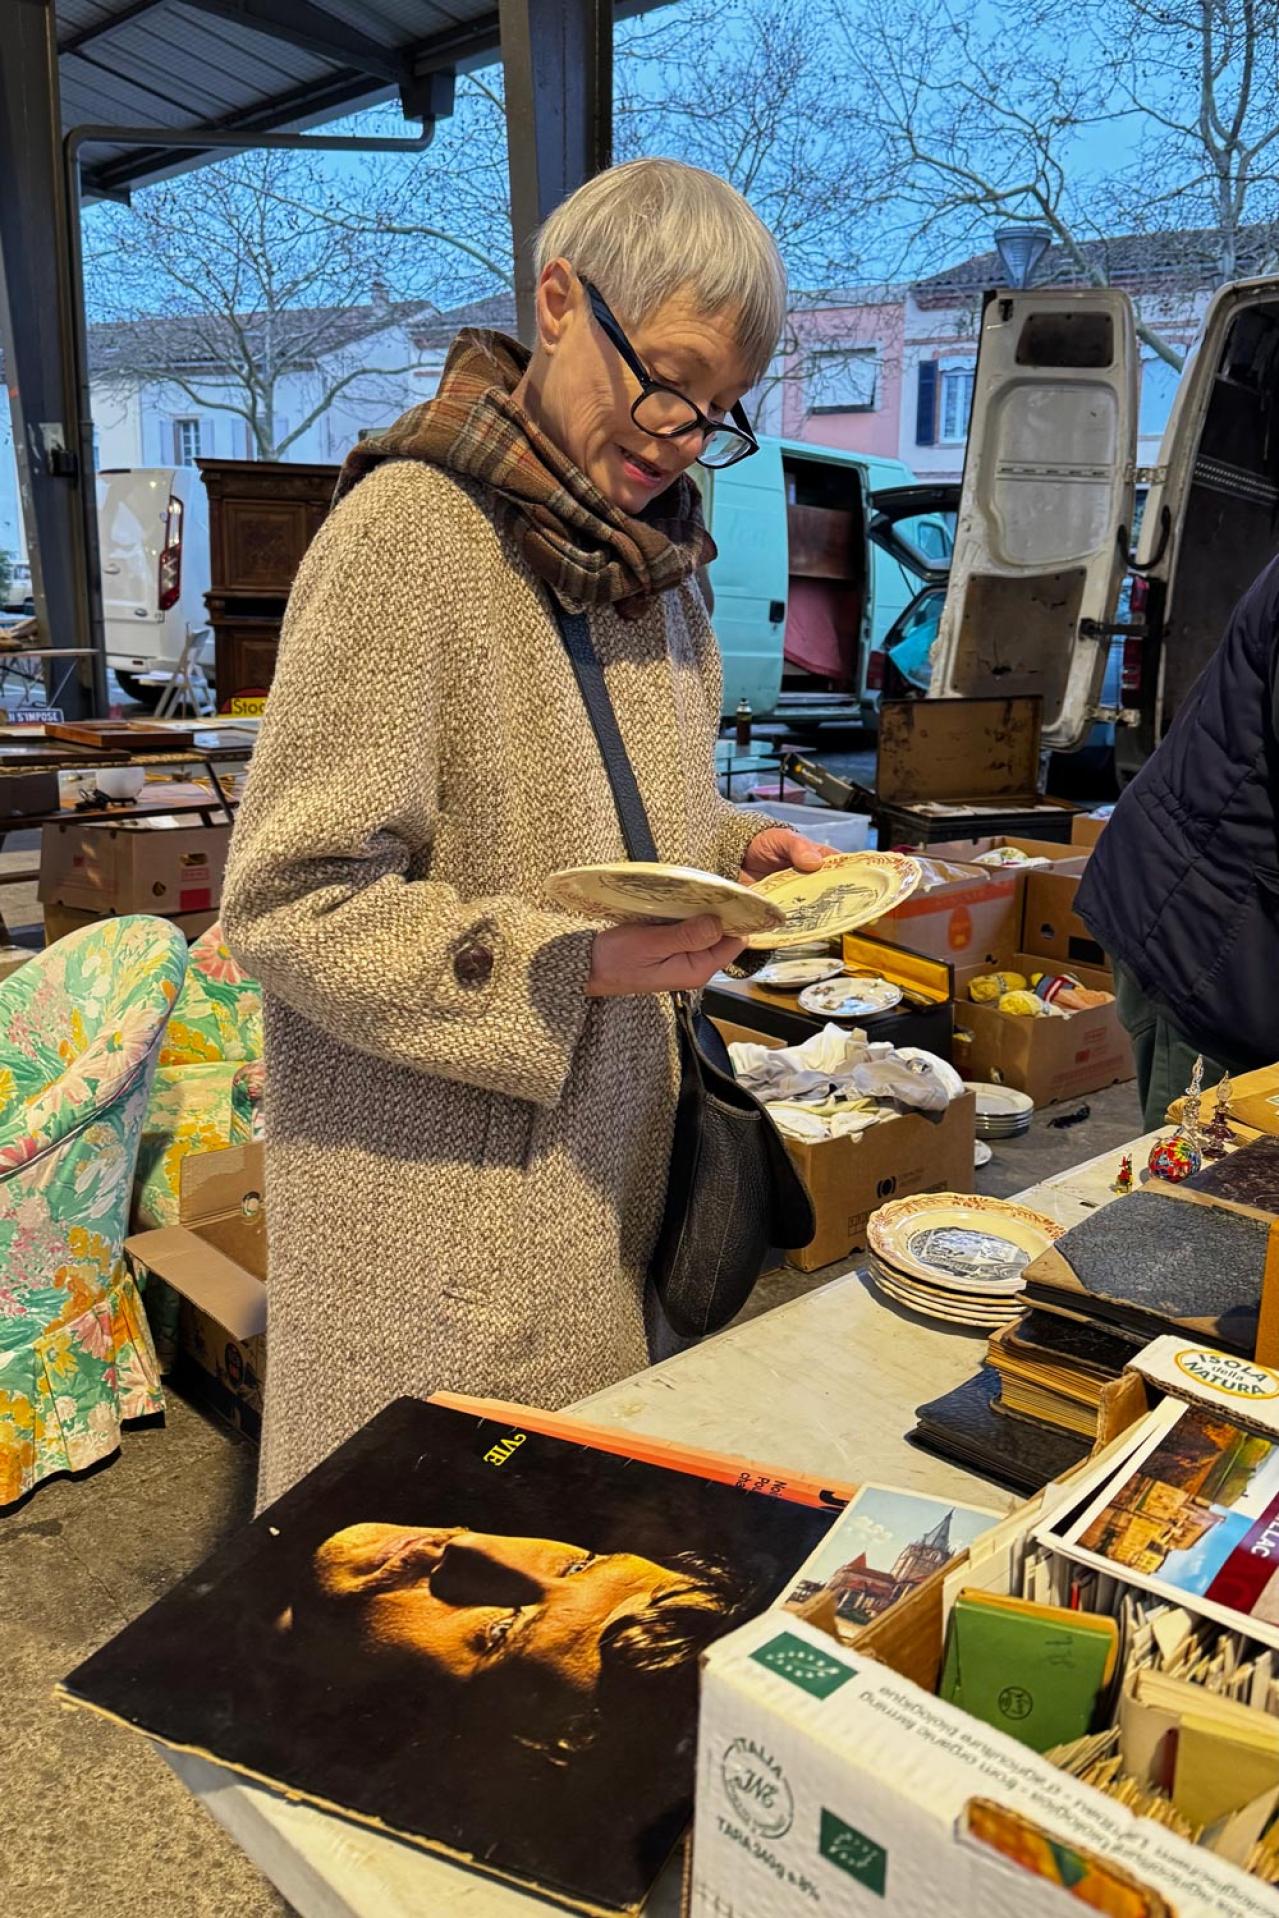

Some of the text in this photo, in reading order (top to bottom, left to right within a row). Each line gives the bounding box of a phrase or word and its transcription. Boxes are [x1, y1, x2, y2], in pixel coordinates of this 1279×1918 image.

[1184, 1361, 1268, 1395] NATURA
[1199, 1354, 1268, 1382] ISOLA
[1211, 1364, 1244, 1381] della
[483, 1433, 527, 1466] VIE
[858, 1691, 916, 1731] farming
[879, 1686, 959, 1737] biologique
[733, 1737, 783, 1779] ITALIA
[916, 1727, 977, 1765] organic
[979, 1761, 1018, 1789] from
[717, 1816, 754, 1850] TARA
